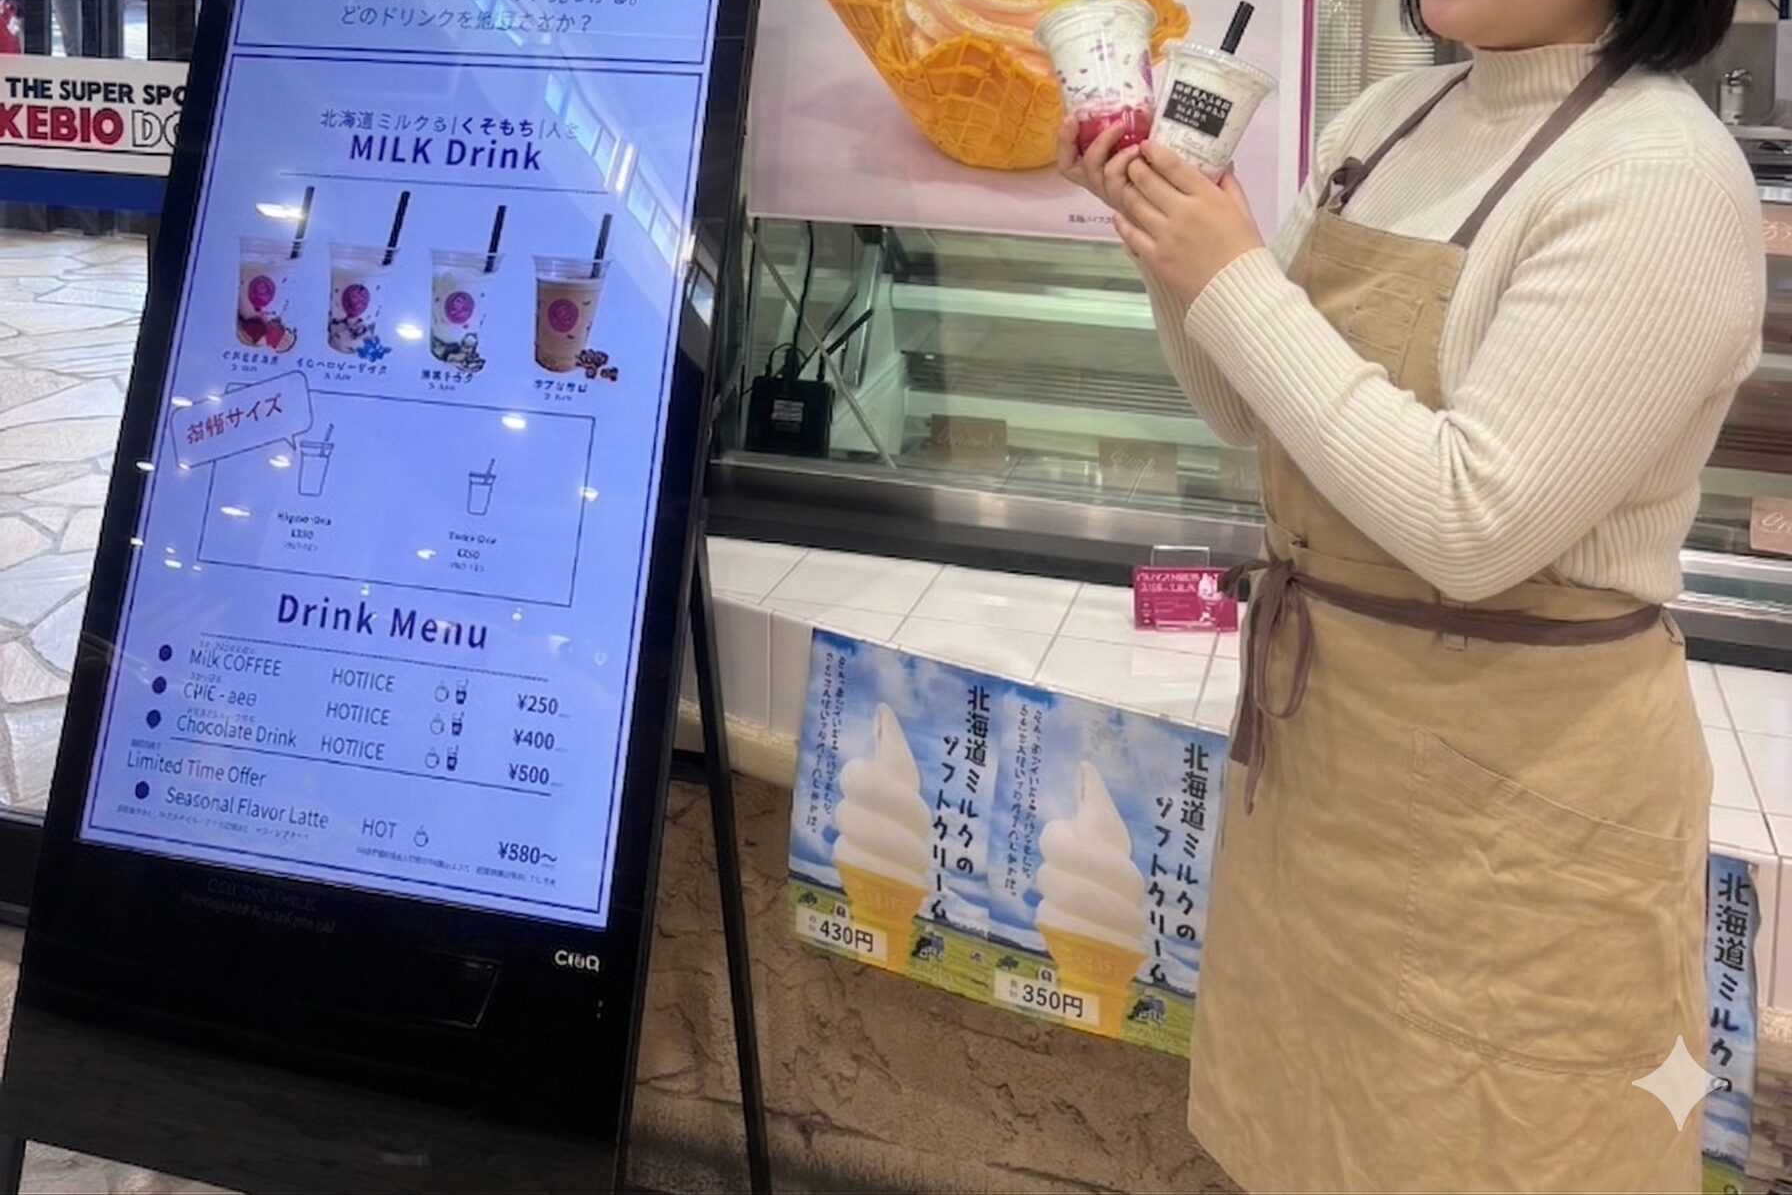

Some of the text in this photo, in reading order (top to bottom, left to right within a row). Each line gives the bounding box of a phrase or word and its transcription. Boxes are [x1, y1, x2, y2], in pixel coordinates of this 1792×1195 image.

[5, 76, 52, 99] THE
[59, 80, 135, 104] SUPER
[350, 134, 543, 171] MILK Drink
[278, 593, 488, 649] Drink Menu
[223, 653, 282, 676] COFFEE
[518, 693, 559, 716] ¥250
[176, 714, 252, 741] Chocolate
[256, 726, 297, 748] Drink
[508, 762, 550, 785] ¥500
[513, 728, 555, 751] ¥400
[127, 750, 267, 788] Limited Time Offer
[956, 686, 990, 874] 北海道ミルクの
[165, 786, 234, 814] Seasonal
[238, 798, 285, 822] Flavor
[289, 806, 329, 830] Latte
[361, 818, 397, 840] HOT
[1176, 743, 1209, 941] 北海道ミルクの
[819, 920, 873, 952] 430円
[1022, 984, 1083, 1018] 350円
